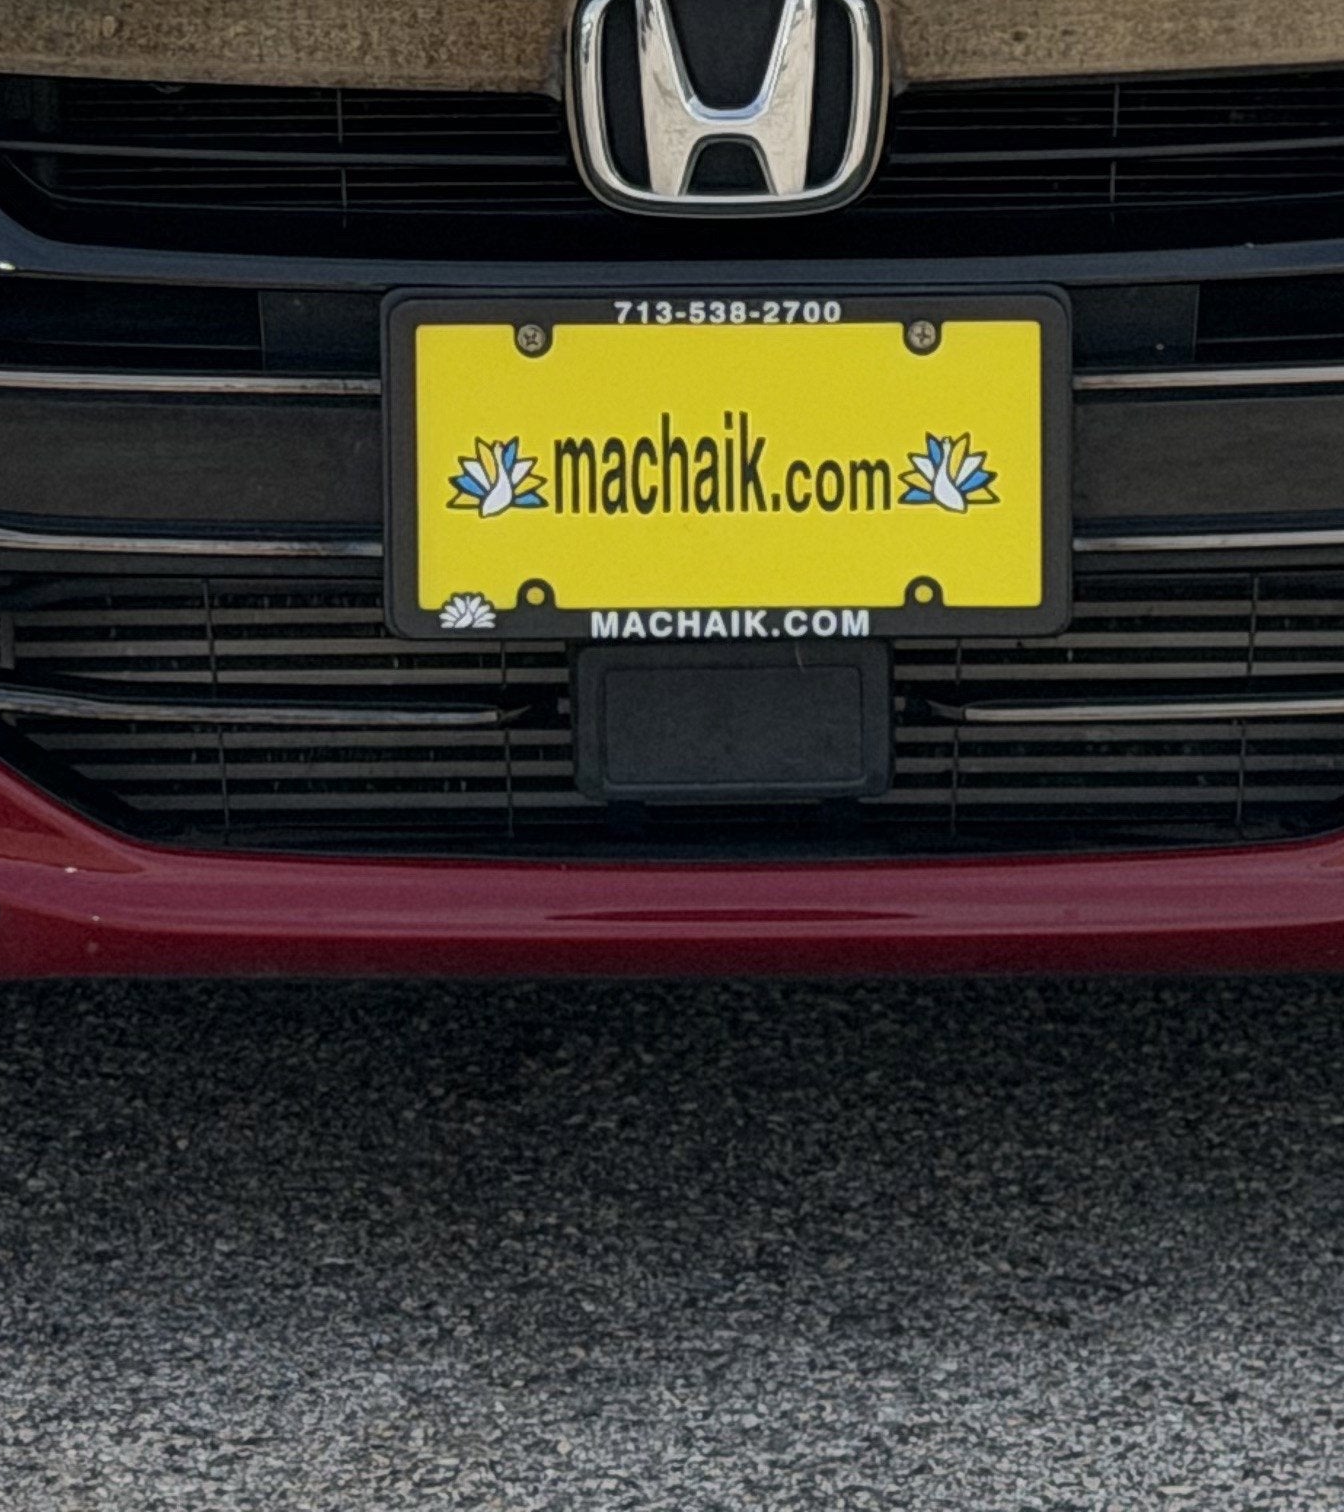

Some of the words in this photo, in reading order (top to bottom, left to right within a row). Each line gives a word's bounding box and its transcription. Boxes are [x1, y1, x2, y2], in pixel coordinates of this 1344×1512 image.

[613, 300, 842, 325] 713-538-2700
[553, 411, 891, 514] machaik.com
[590, 608, 871, 639] MACHAIK.COM
